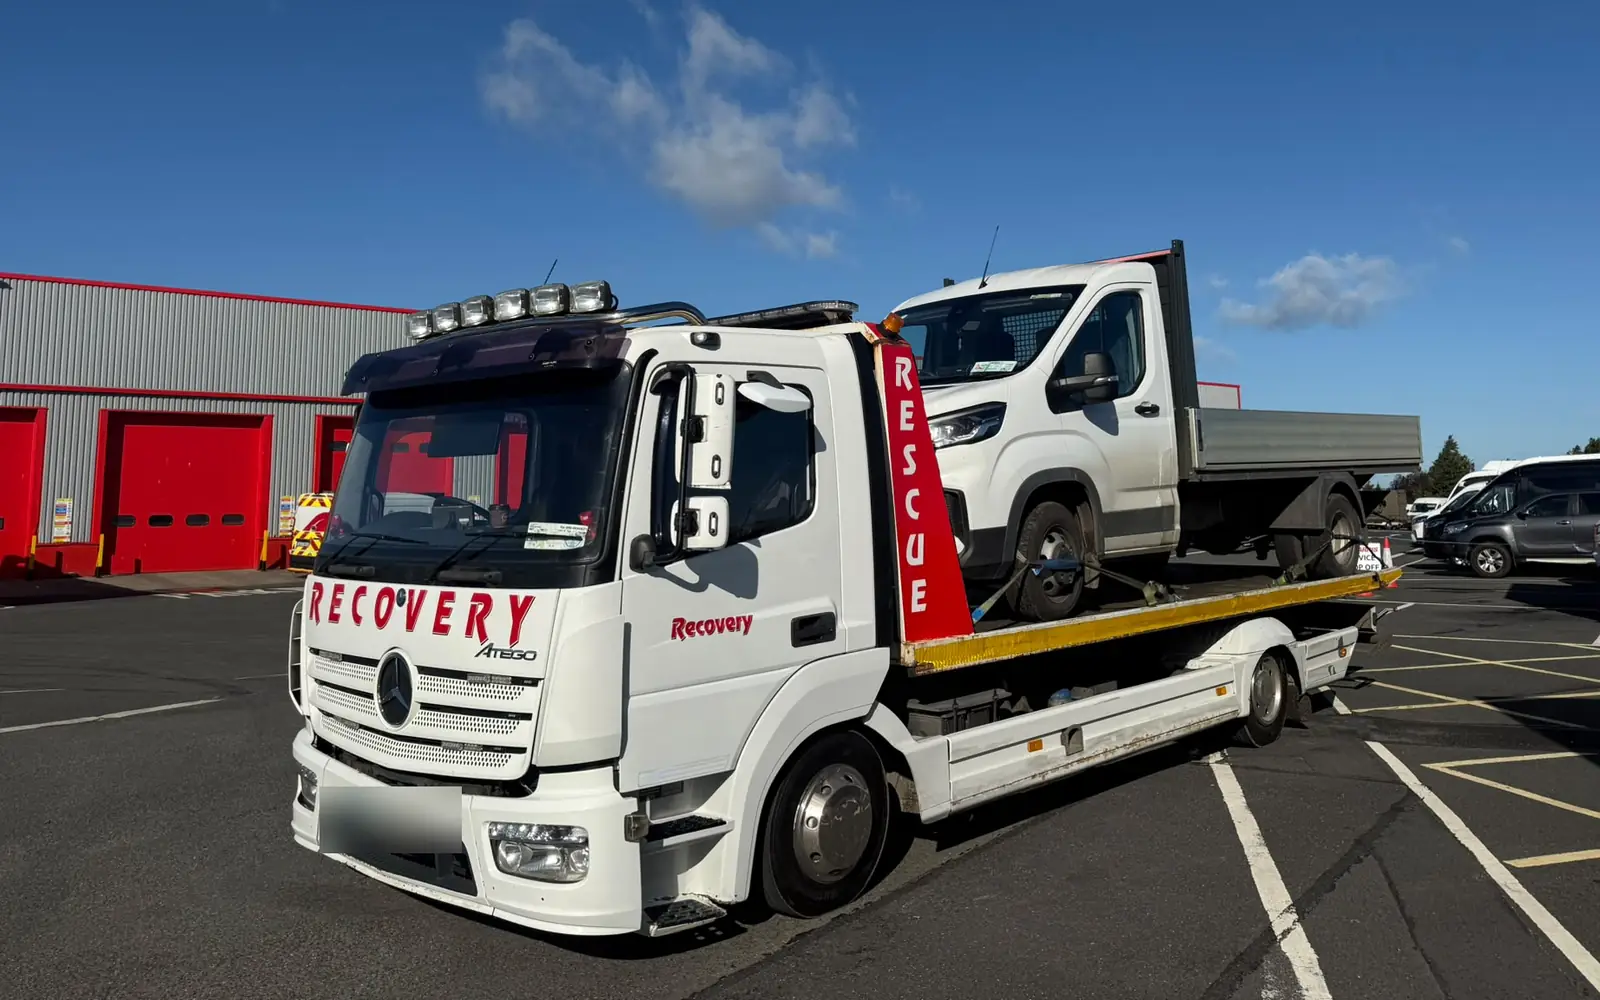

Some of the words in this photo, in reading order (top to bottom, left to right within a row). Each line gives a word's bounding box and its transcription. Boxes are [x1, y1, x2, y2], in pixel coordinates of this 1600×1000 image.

[895, 356, 927, 613] RESCUE
[309, 581, 536, 648] RECOVERY
[671, 614, 753, 641] Recovery
